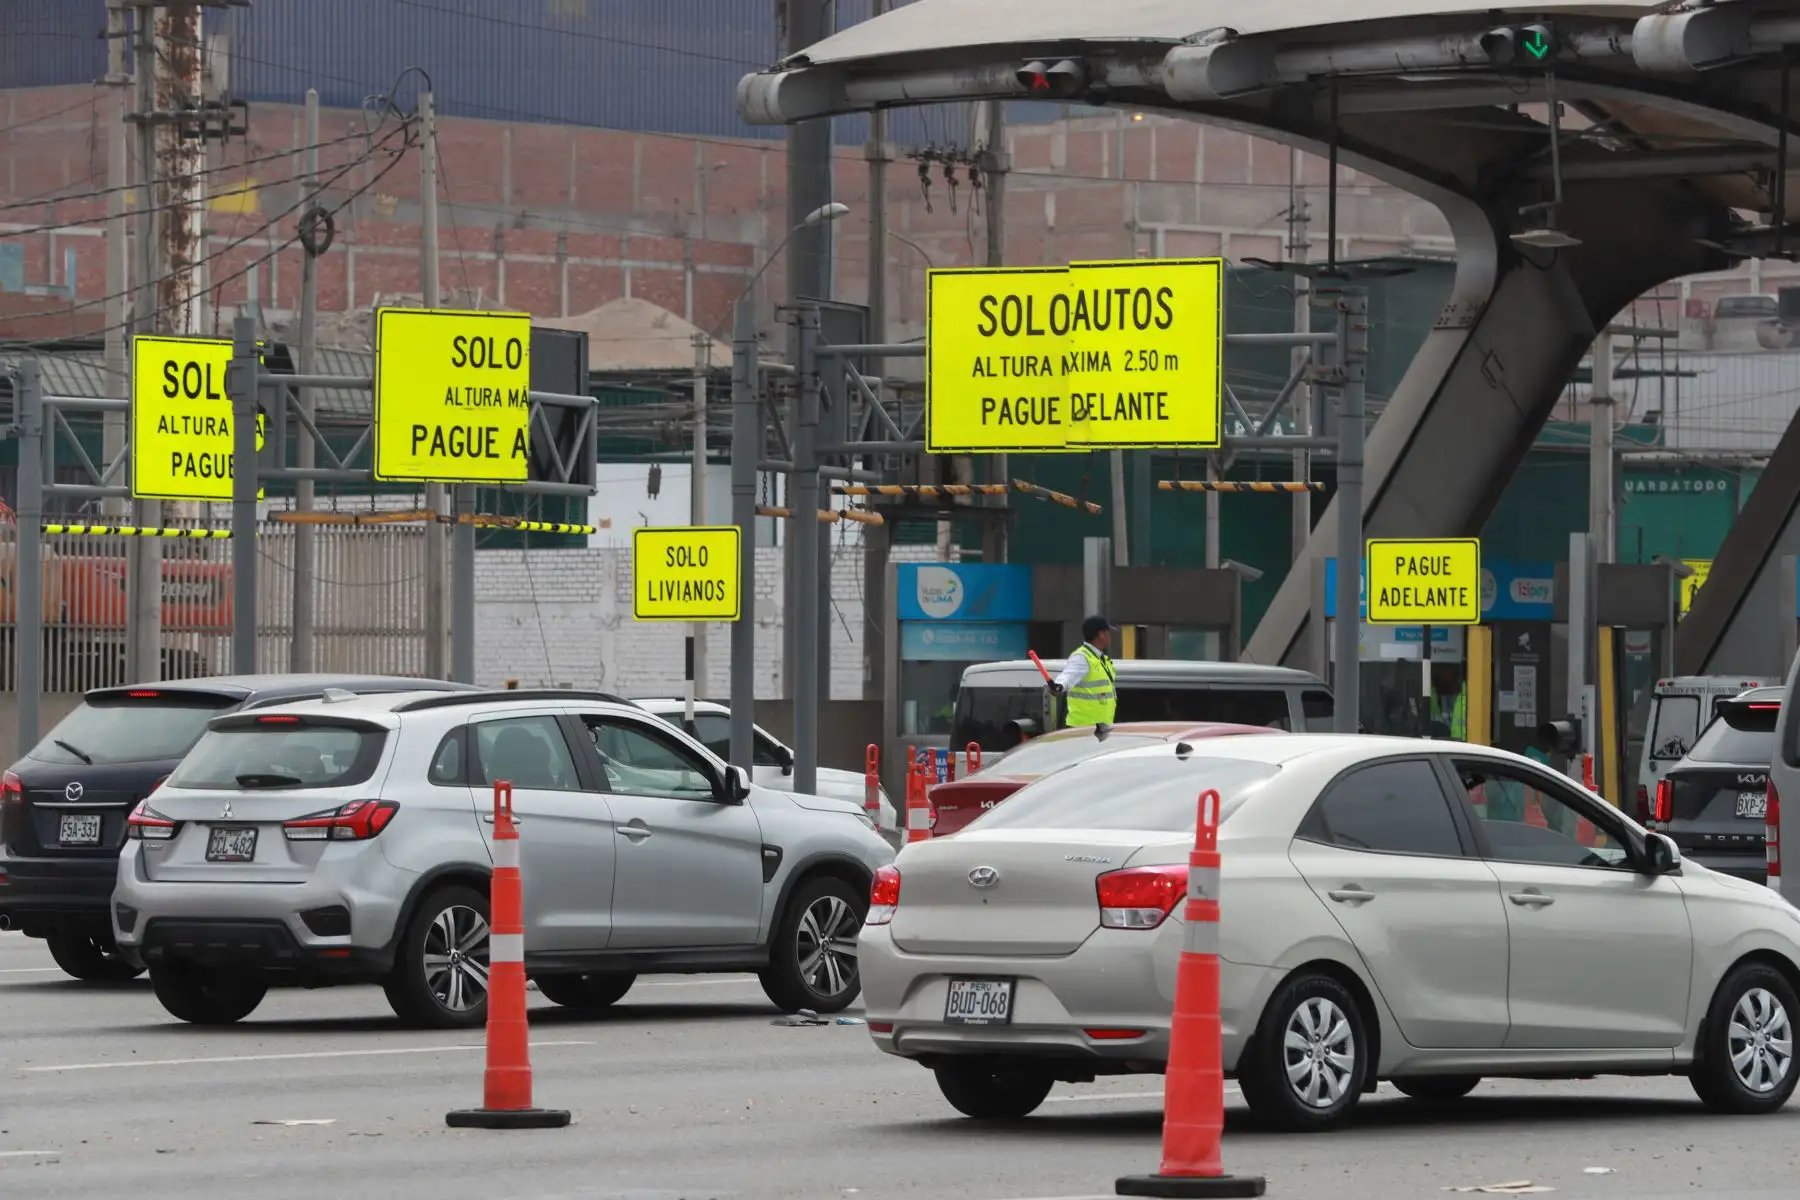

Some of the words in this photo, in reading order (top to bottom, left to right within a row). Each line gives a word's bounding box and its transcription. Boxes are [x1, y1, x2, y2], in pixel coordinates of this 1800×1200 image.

[977, 294, 1070, 337] SOLO
[1072, 287, 1174, 331] AUTOS
[451, 335, 522, 370] SOLO
[972, 356, 1053, 377] ALTURA
[1124, 350, 1158, 372] 2.50
[1164, 354, 1179, 371] m
[163, 360, 229, 400] SOL
[444, 386, 502, 408] ALTURA
[981, 397, 1061, 425] PAGUE
[1071, 392, 1169, 421] DELANTE
[157, 415, 229, 437] ALTURA
[411, 424, 500, 458] PAGUE
[666, 545, 708, 567] SOLO
[1395, 556, 1451, 576] PAGUE
[648, 579, 725, 602] LIVIANOS
[1379, 587, 1468, 607] ADELANTE
[1737, 774, 1767, 784] KIA
[61, 821, 98, 838] F5A-331
[209, 836, 254, 854] CCL-482
[970, 982, 992, 991] PERU
[949, 990, 1008, 1015] BUD-068
